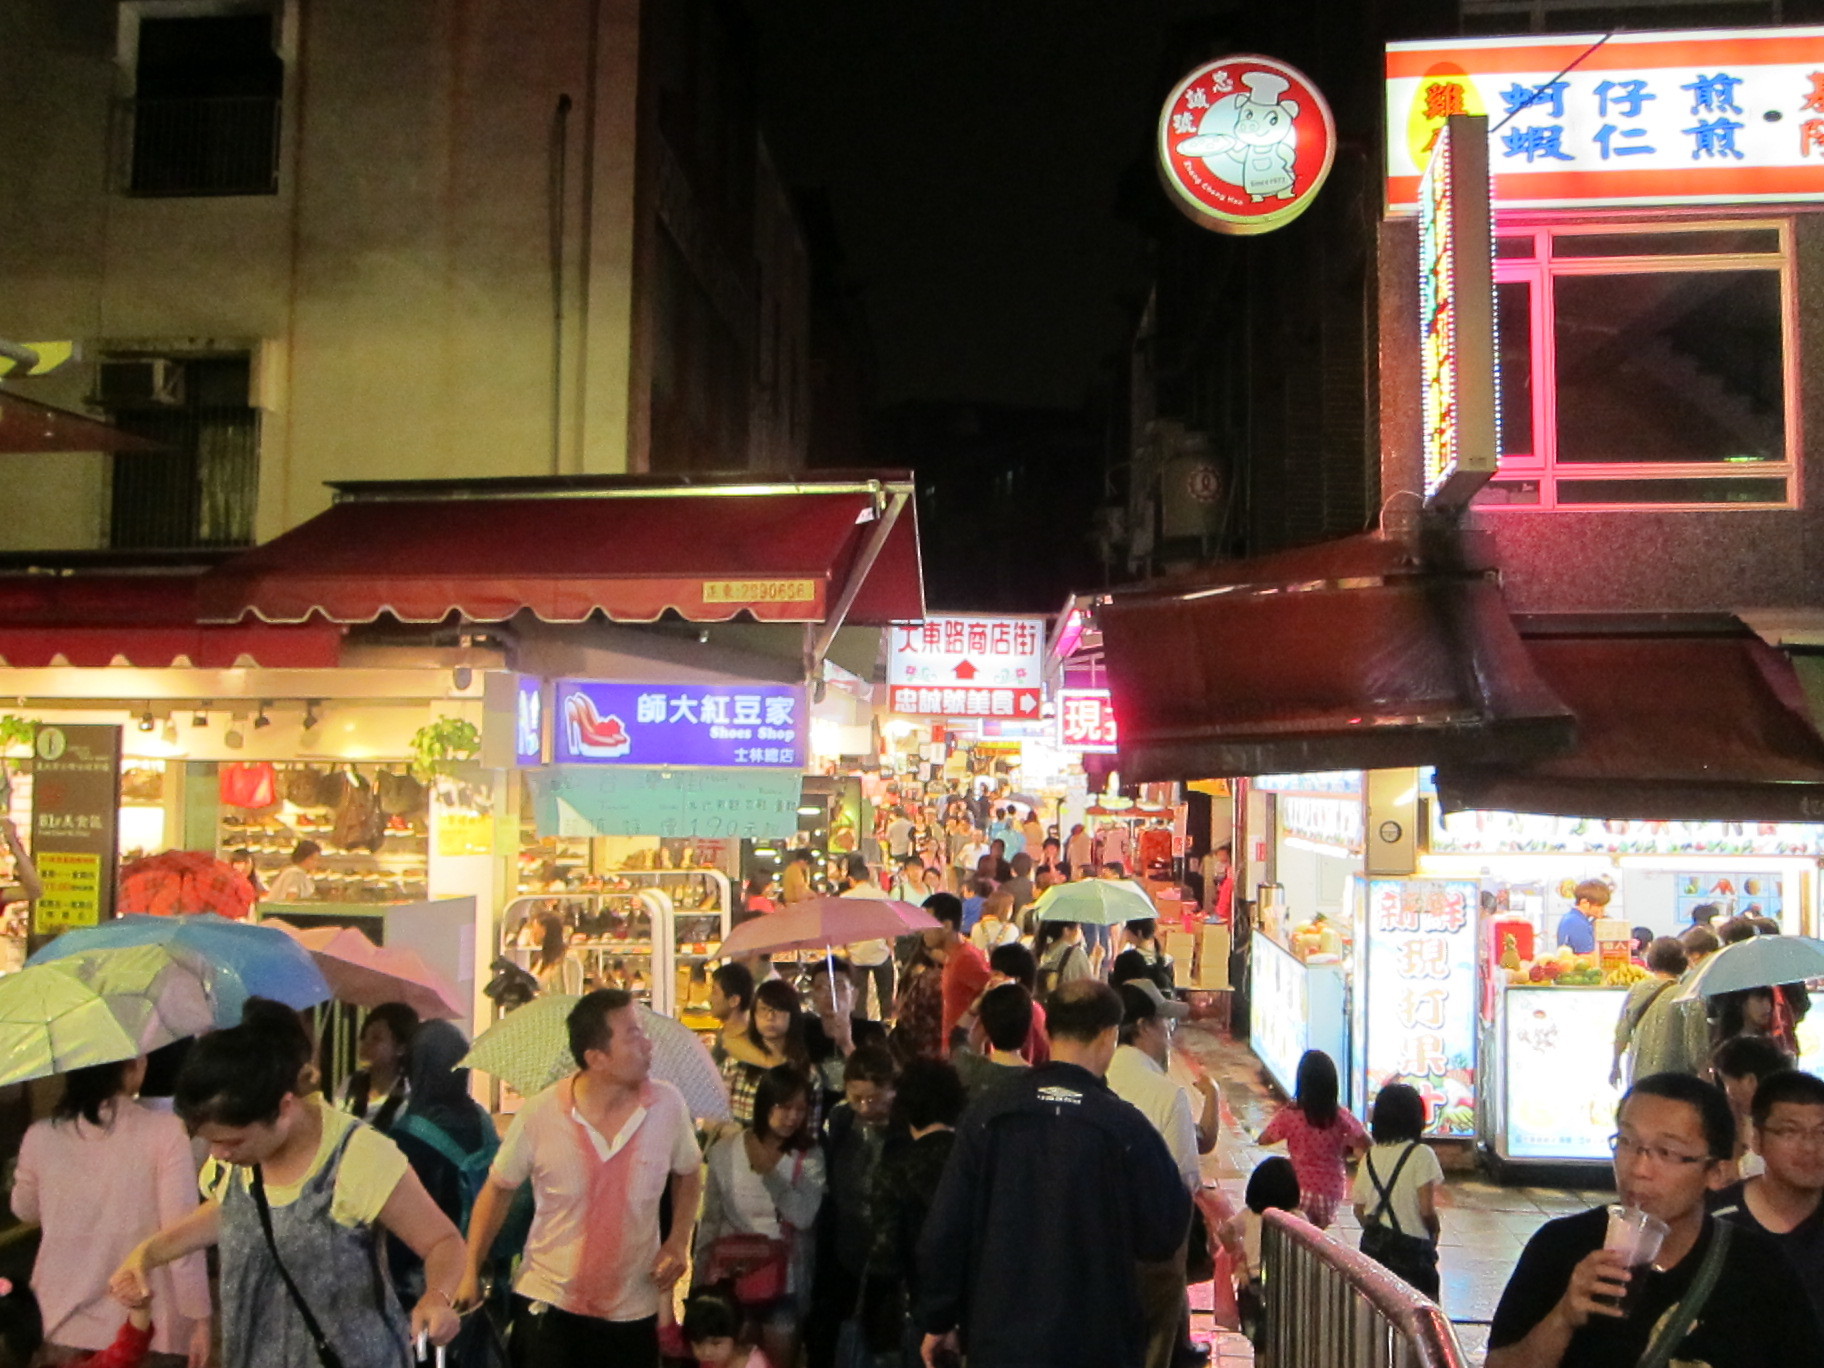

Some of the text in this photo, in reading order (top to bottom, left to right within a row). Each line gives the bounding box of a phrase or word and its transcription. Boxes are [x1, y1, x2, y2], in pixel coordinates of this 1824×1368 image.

[1500, 73, 1744, 117] 蚵仔煎
[1501, 117, 1745, 163] 蝦仁煎
[898, 620, 1036, 657] 大東路商店街
[637, 693, 795, 726] 師大紅豆家
[895, 687, 1015, 715] 忠誠號美食
[710, 726, 795, 743] Shoes Shop
[1380, 891, 1466, 934] 新鮮
